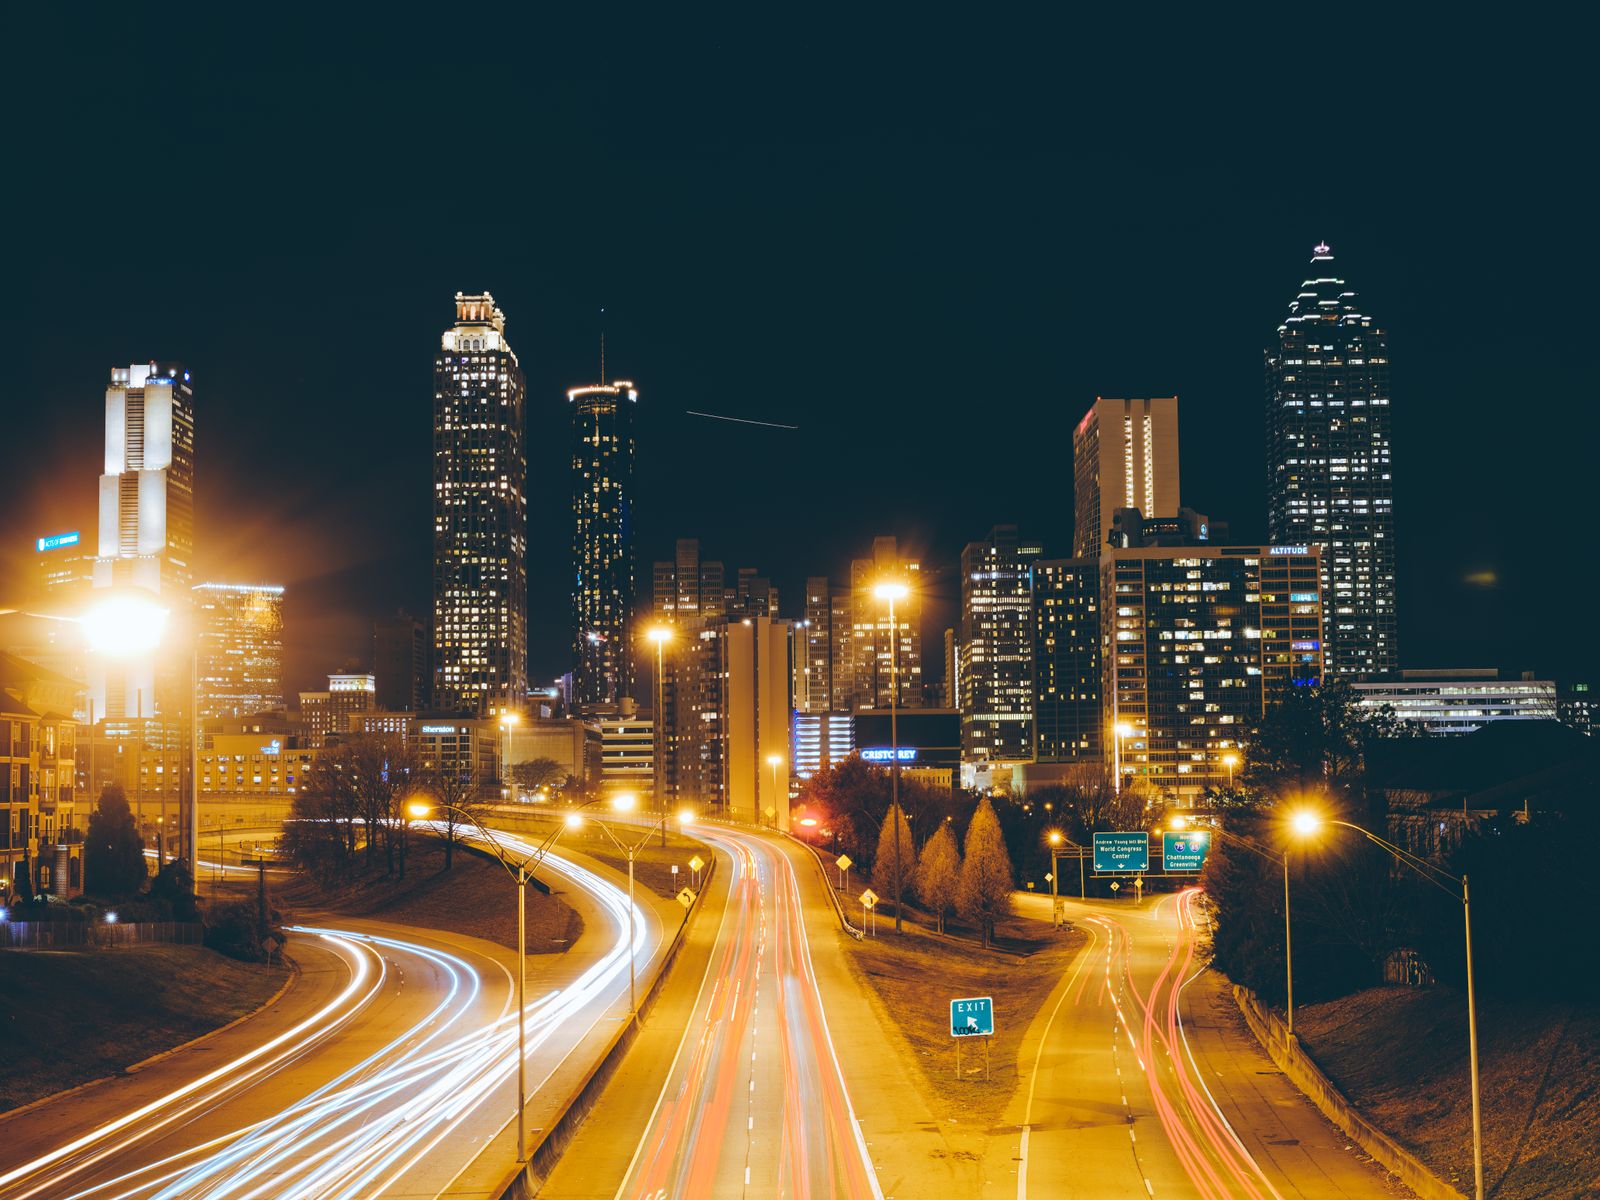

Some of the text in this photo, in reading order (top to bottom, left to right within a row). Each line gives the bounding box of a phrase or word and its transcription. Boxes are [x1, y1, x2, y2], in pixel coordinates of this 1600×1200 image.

[422, 725, 455, 733] Sheraton
[897, 750, 916, 759] REY
[958, 1002, 985, 1012] EXIT
